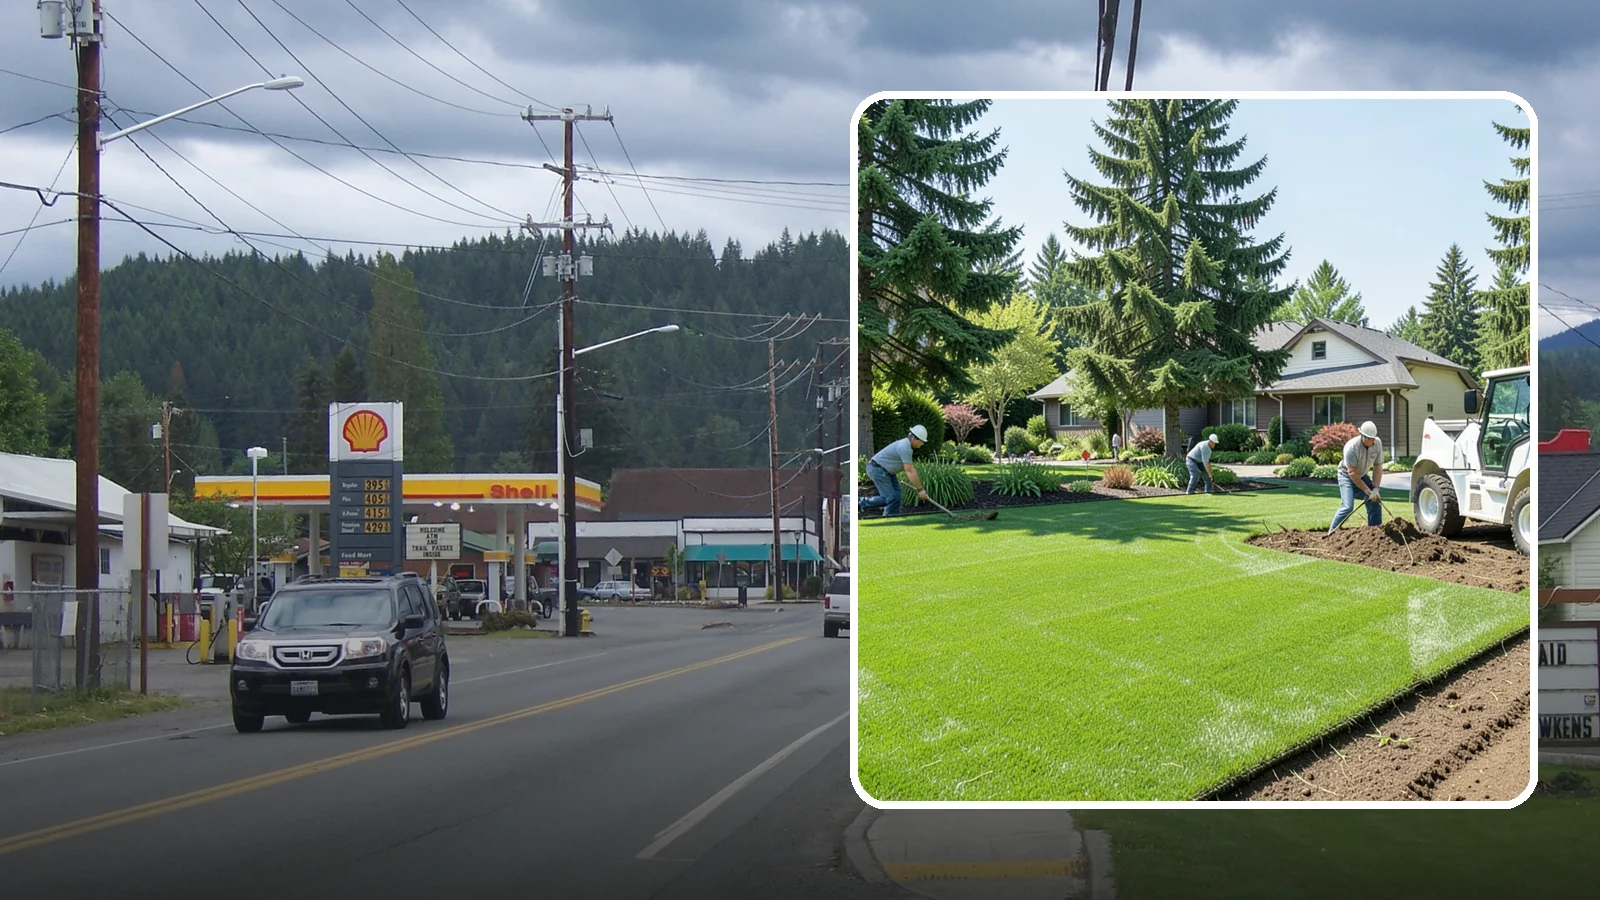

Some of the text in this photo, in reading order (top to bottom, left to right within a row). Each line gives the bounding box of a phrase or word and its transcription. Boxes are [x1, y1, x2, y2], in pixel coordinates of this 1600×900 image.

[365, 480, 384, 490] 395
[490, 484, 547, 499] Shell
[365, 494, 384, 504] 405
[365, 508, 384, 518] 415
[365, 522, 384, 533] 429
